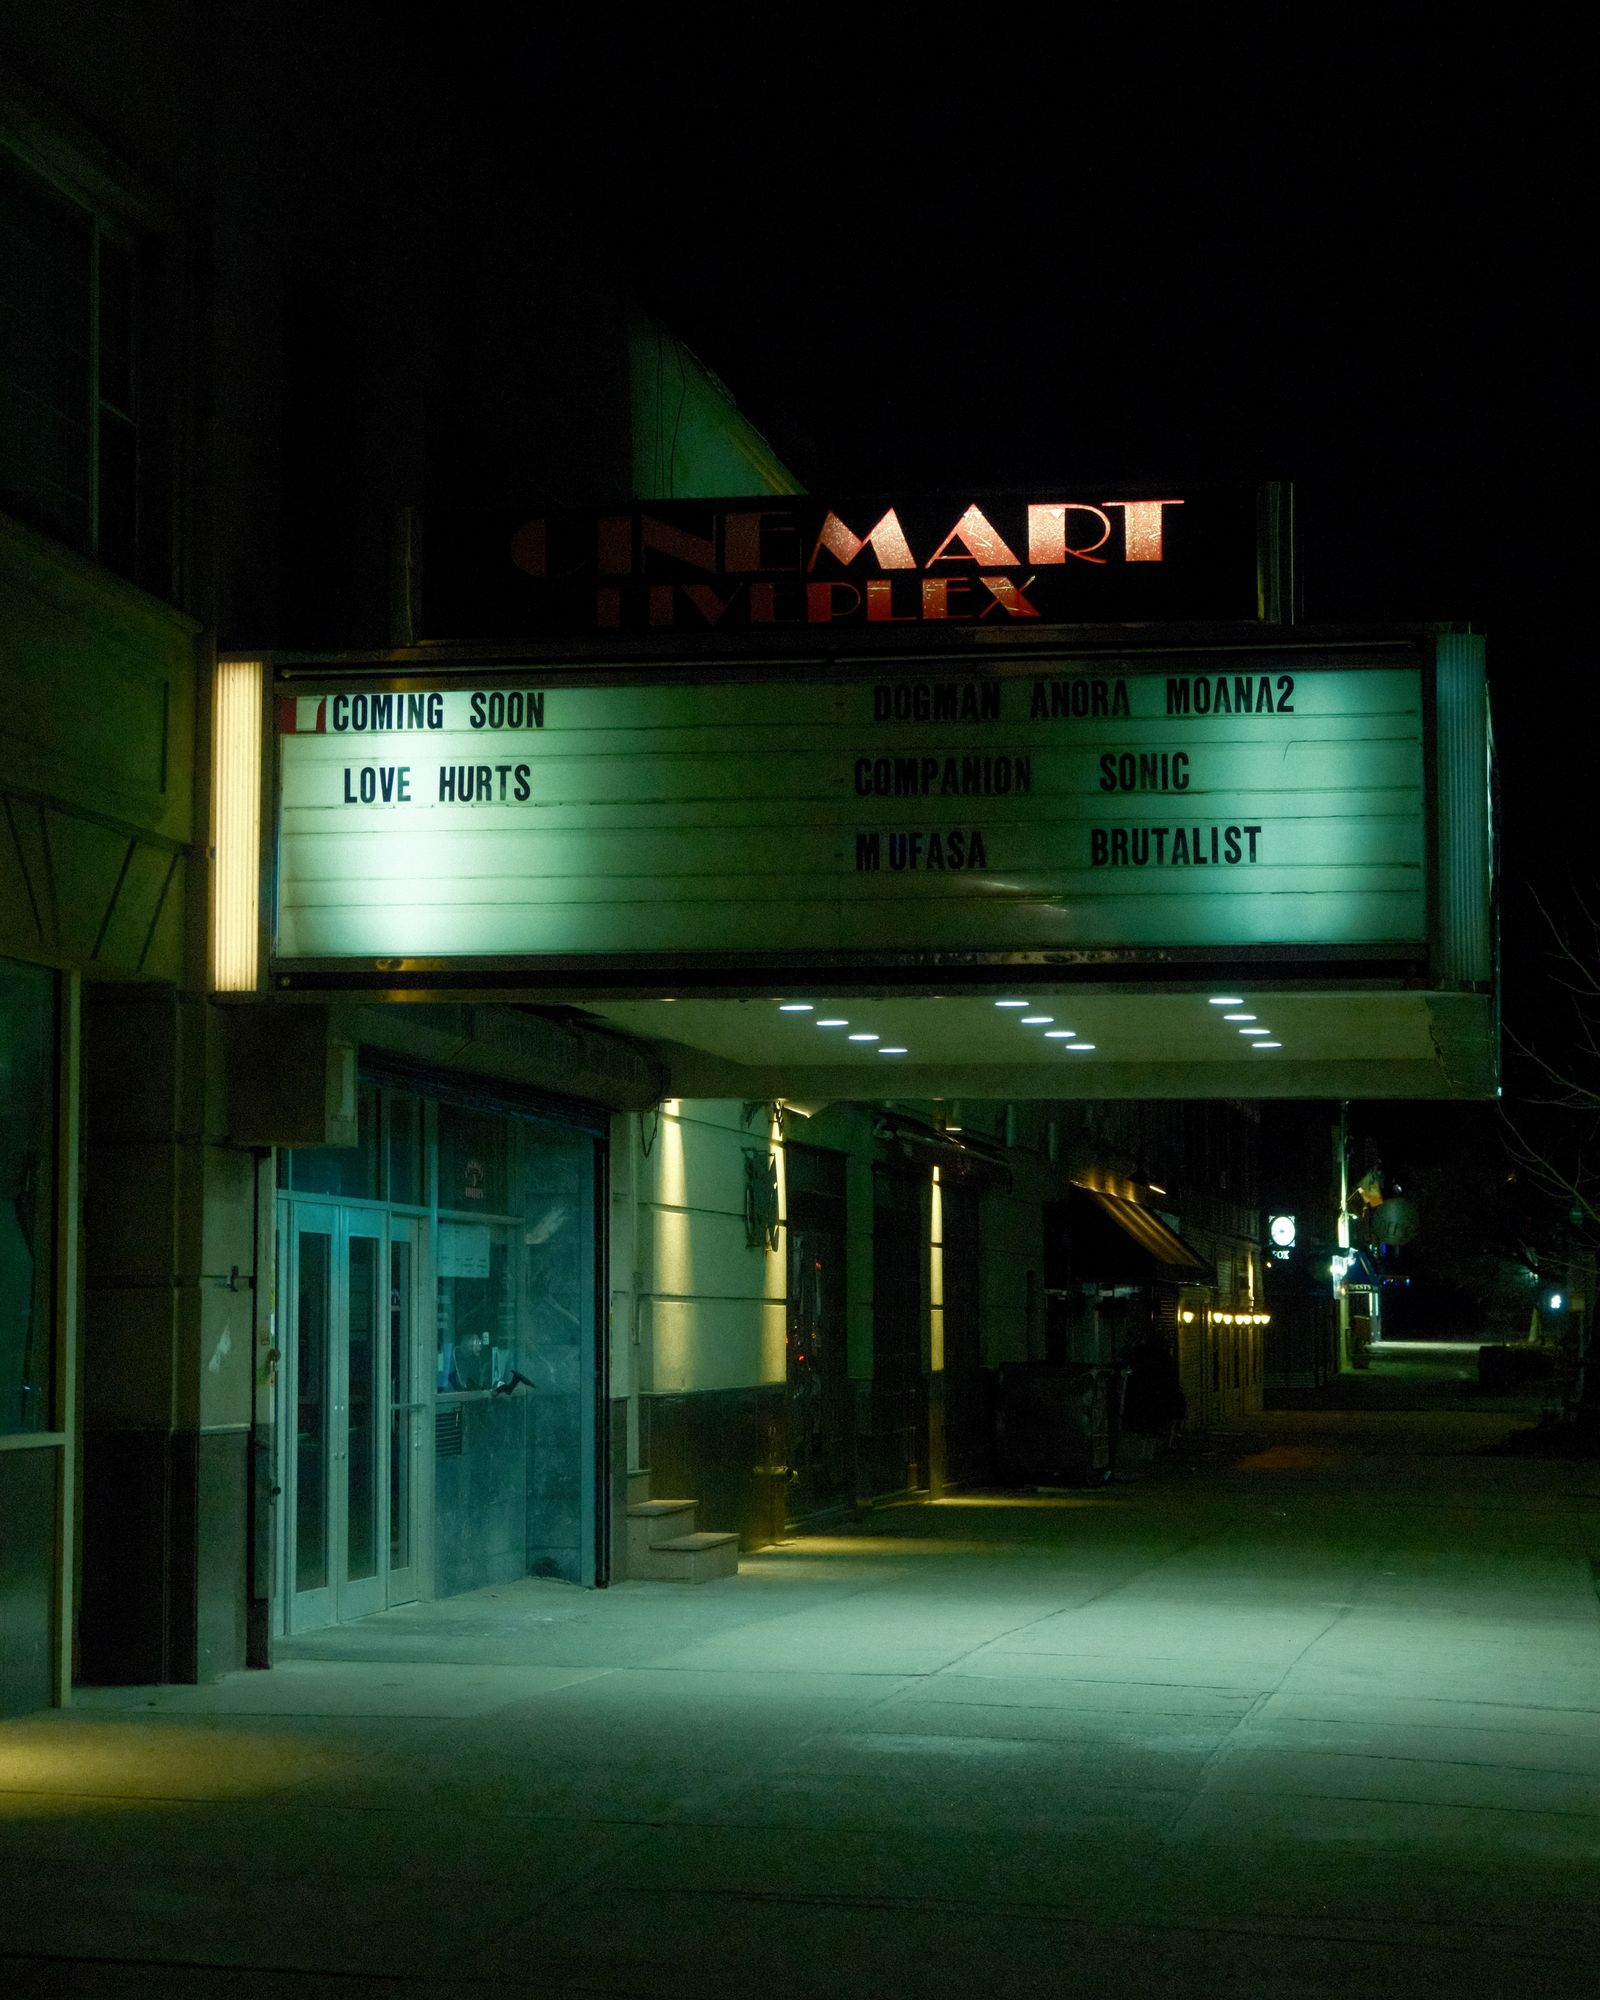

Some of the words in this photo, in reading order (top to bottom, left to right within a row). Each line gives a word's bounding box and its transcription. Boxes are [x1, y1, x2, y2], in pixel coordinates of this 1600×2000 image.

[510, 499, 1186, 578] CINEMART
[332, 692, 444, 733] COMING
[470, 690, 545, 729] SOON
[873, 680, 1000, 721] DOGMAN
[1030, 677, 1131, 718] ANORA
[1166, 675, 1296, 715] MOANA2
[343, 766, 411, 804] LOVE
[438, 764, 531, 803] HURTS
[854, 756, 1031, 797] COMPANION
[1099, 752, 1190, 792] SONIC
[856, 831, 986, 872] MUFASA
[1091, 826, 1262, 867] BRUTALIST
